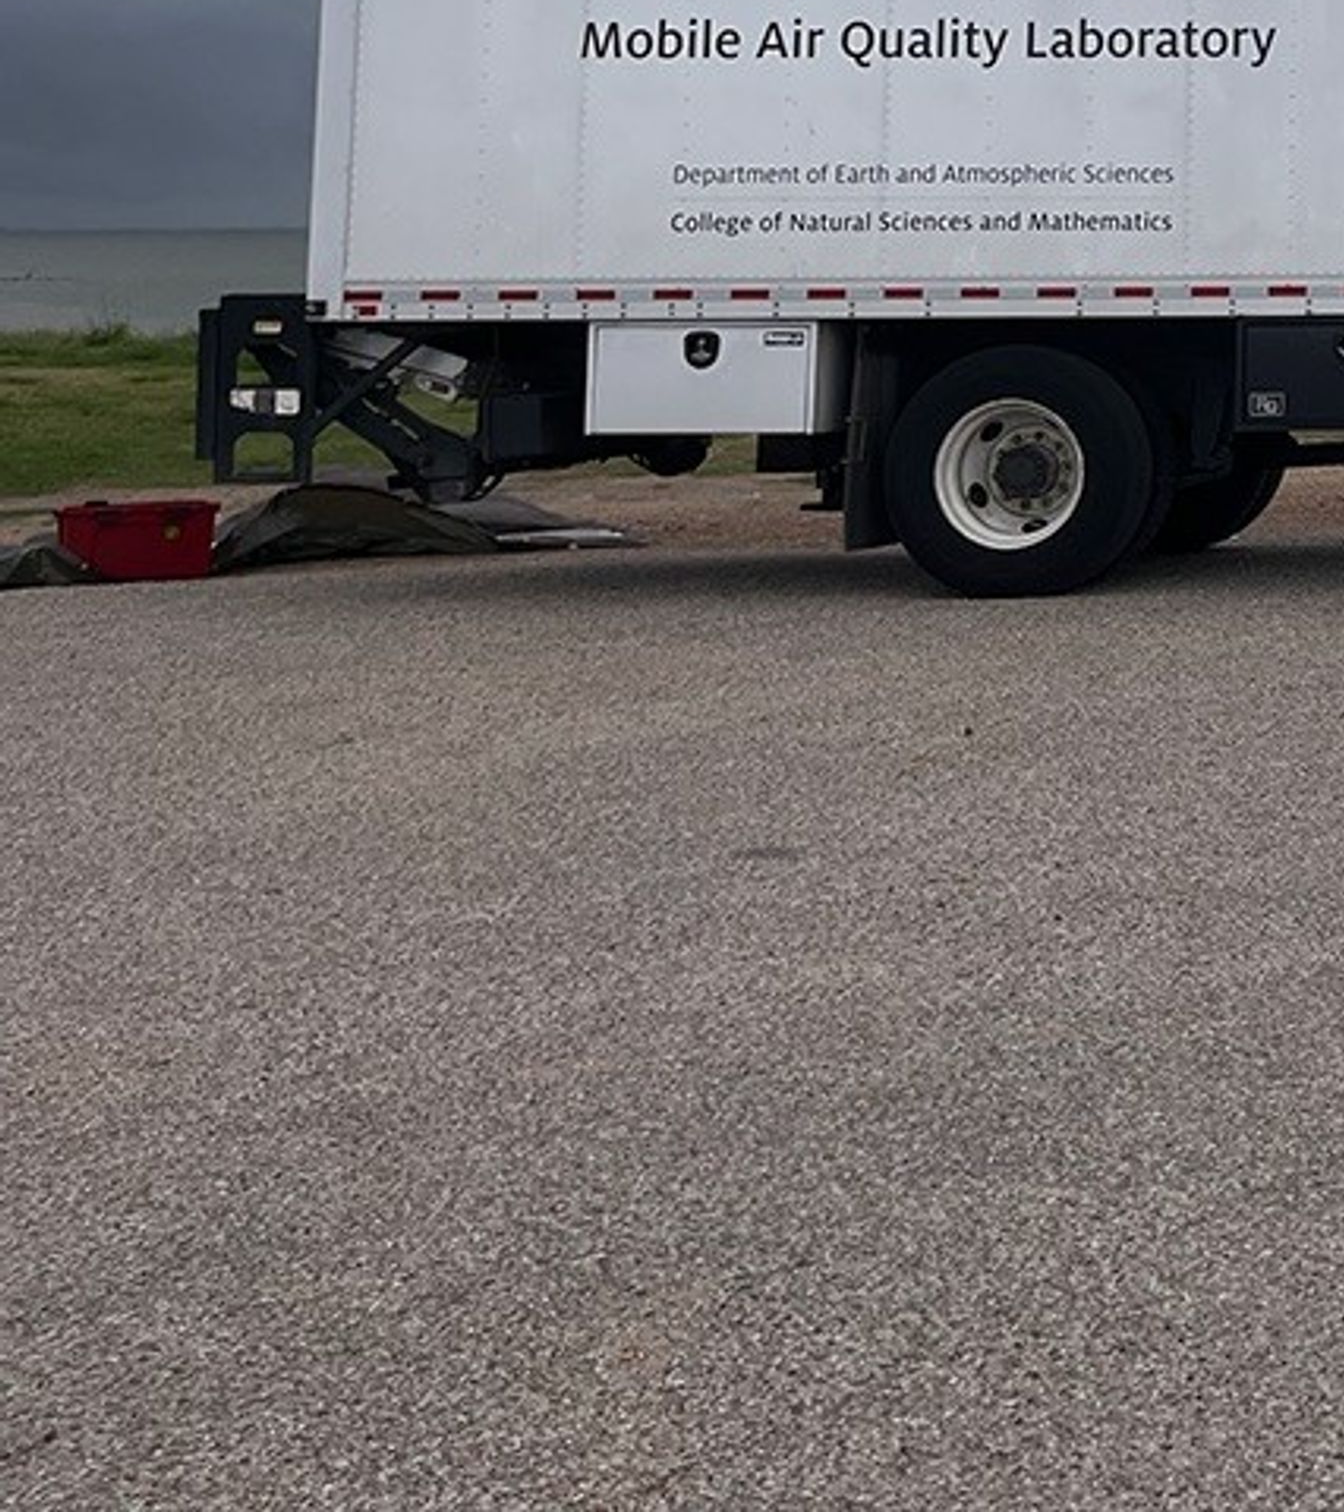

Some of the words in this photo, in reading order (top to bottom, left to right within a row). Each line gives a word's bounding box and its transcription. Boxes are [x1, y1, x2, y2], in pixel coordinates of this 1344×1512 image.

[581, 18, 741, 60] Mobile
[756, 18, 824, 59] Air
[840, 17, 1008, 70] Quality
[1026, 18, 1277, 68] Laboratory
[673, 163, 801, 188] Department
[805, 163, 829, 185] of
[835, 163, 890, 184] Earth
[895, 163, 936, 184] and
[941, 163, 1077, 188] Atmospheric
[1083, 163, 1175, 184] Sciences
[670, 211, 754, 237] College
[758, 211, 783, 232] of
[789, 211, 872, 232] Natural
[878, 211, 974, 232] Sciences
[979, 211, 1022, 232] and
[1027, 211, 1174, 232] Mathematics
